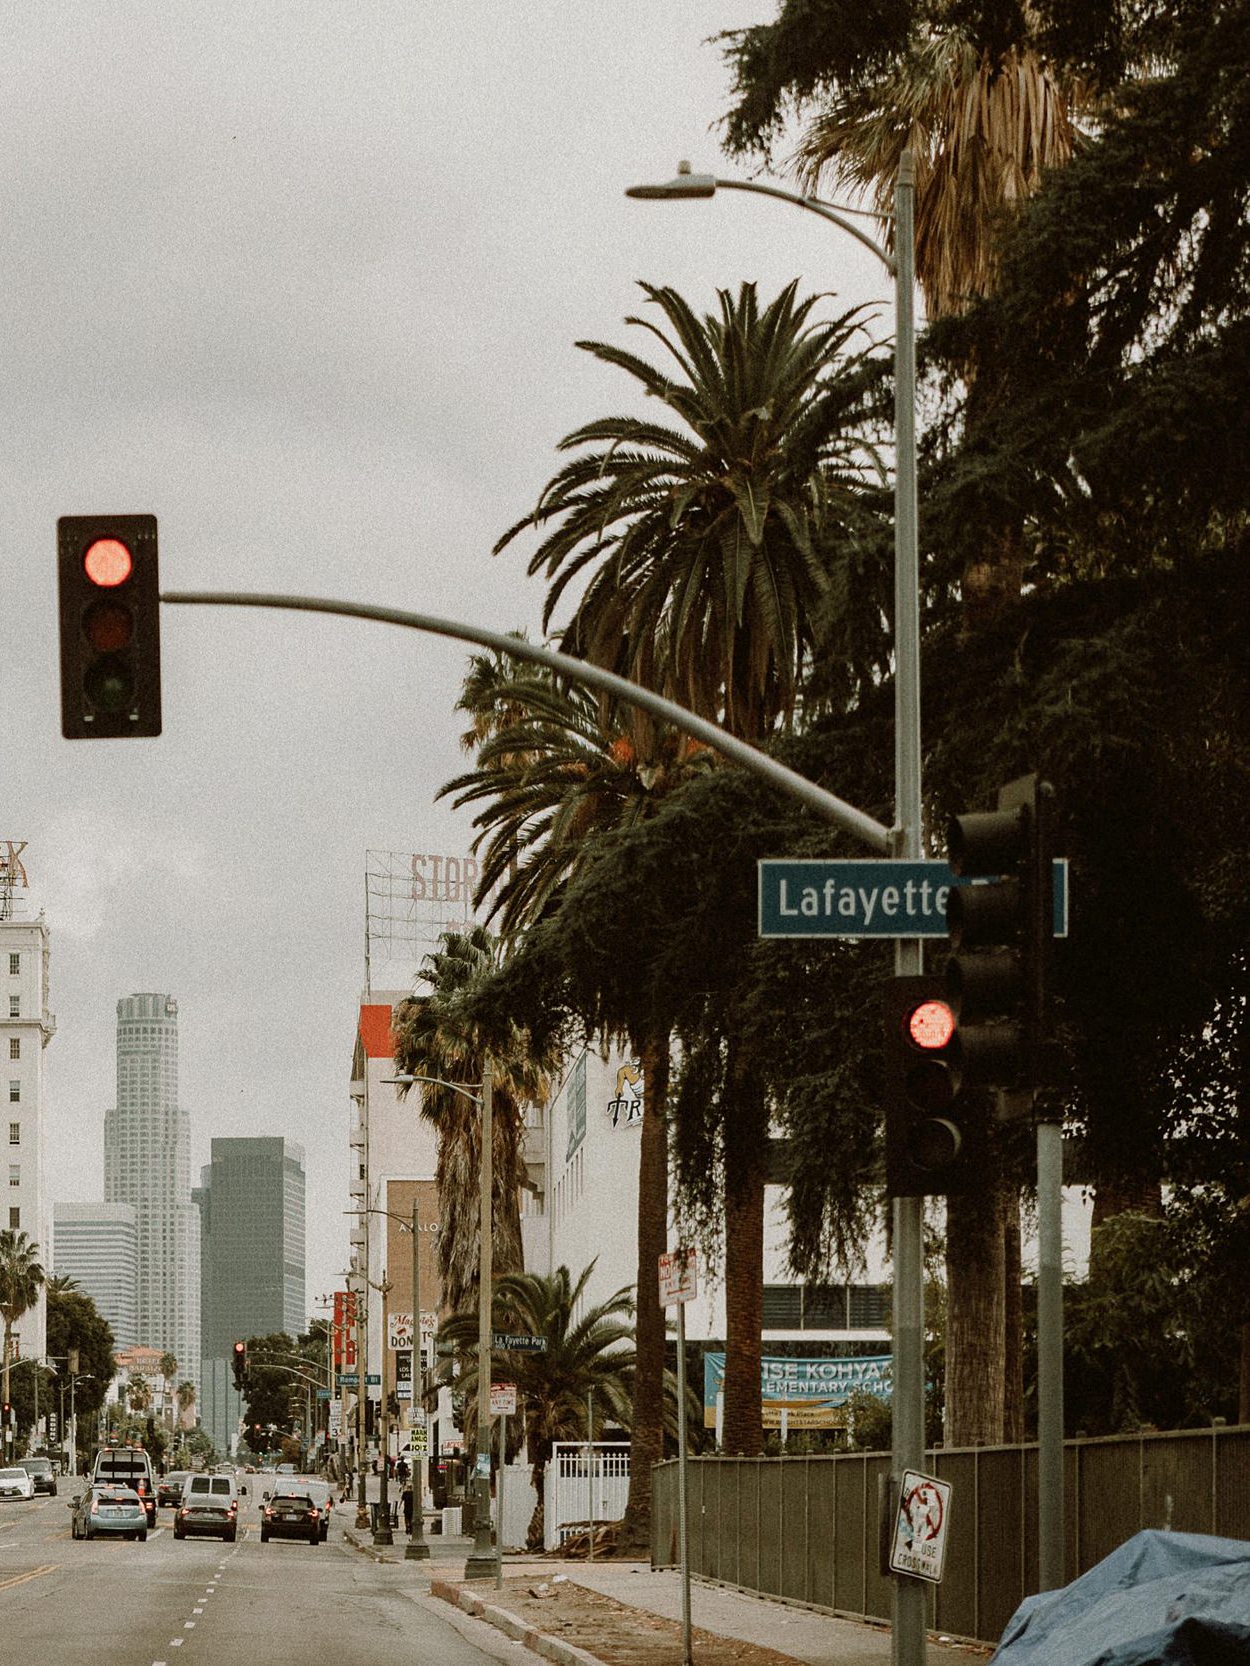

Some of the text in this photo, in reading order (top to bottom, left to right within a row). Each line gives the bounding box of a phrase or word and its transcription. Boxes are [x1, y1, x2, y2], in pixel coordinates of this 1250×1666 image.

[411, 854, 478, 901] STOR
[779, 878, 951, 926] Lafayette
[391, 1331, 434, 1348] DONTS
[762, 1361, 892, 1380] ISE KOHYA
[921, 1543, 937, 1559] USE
